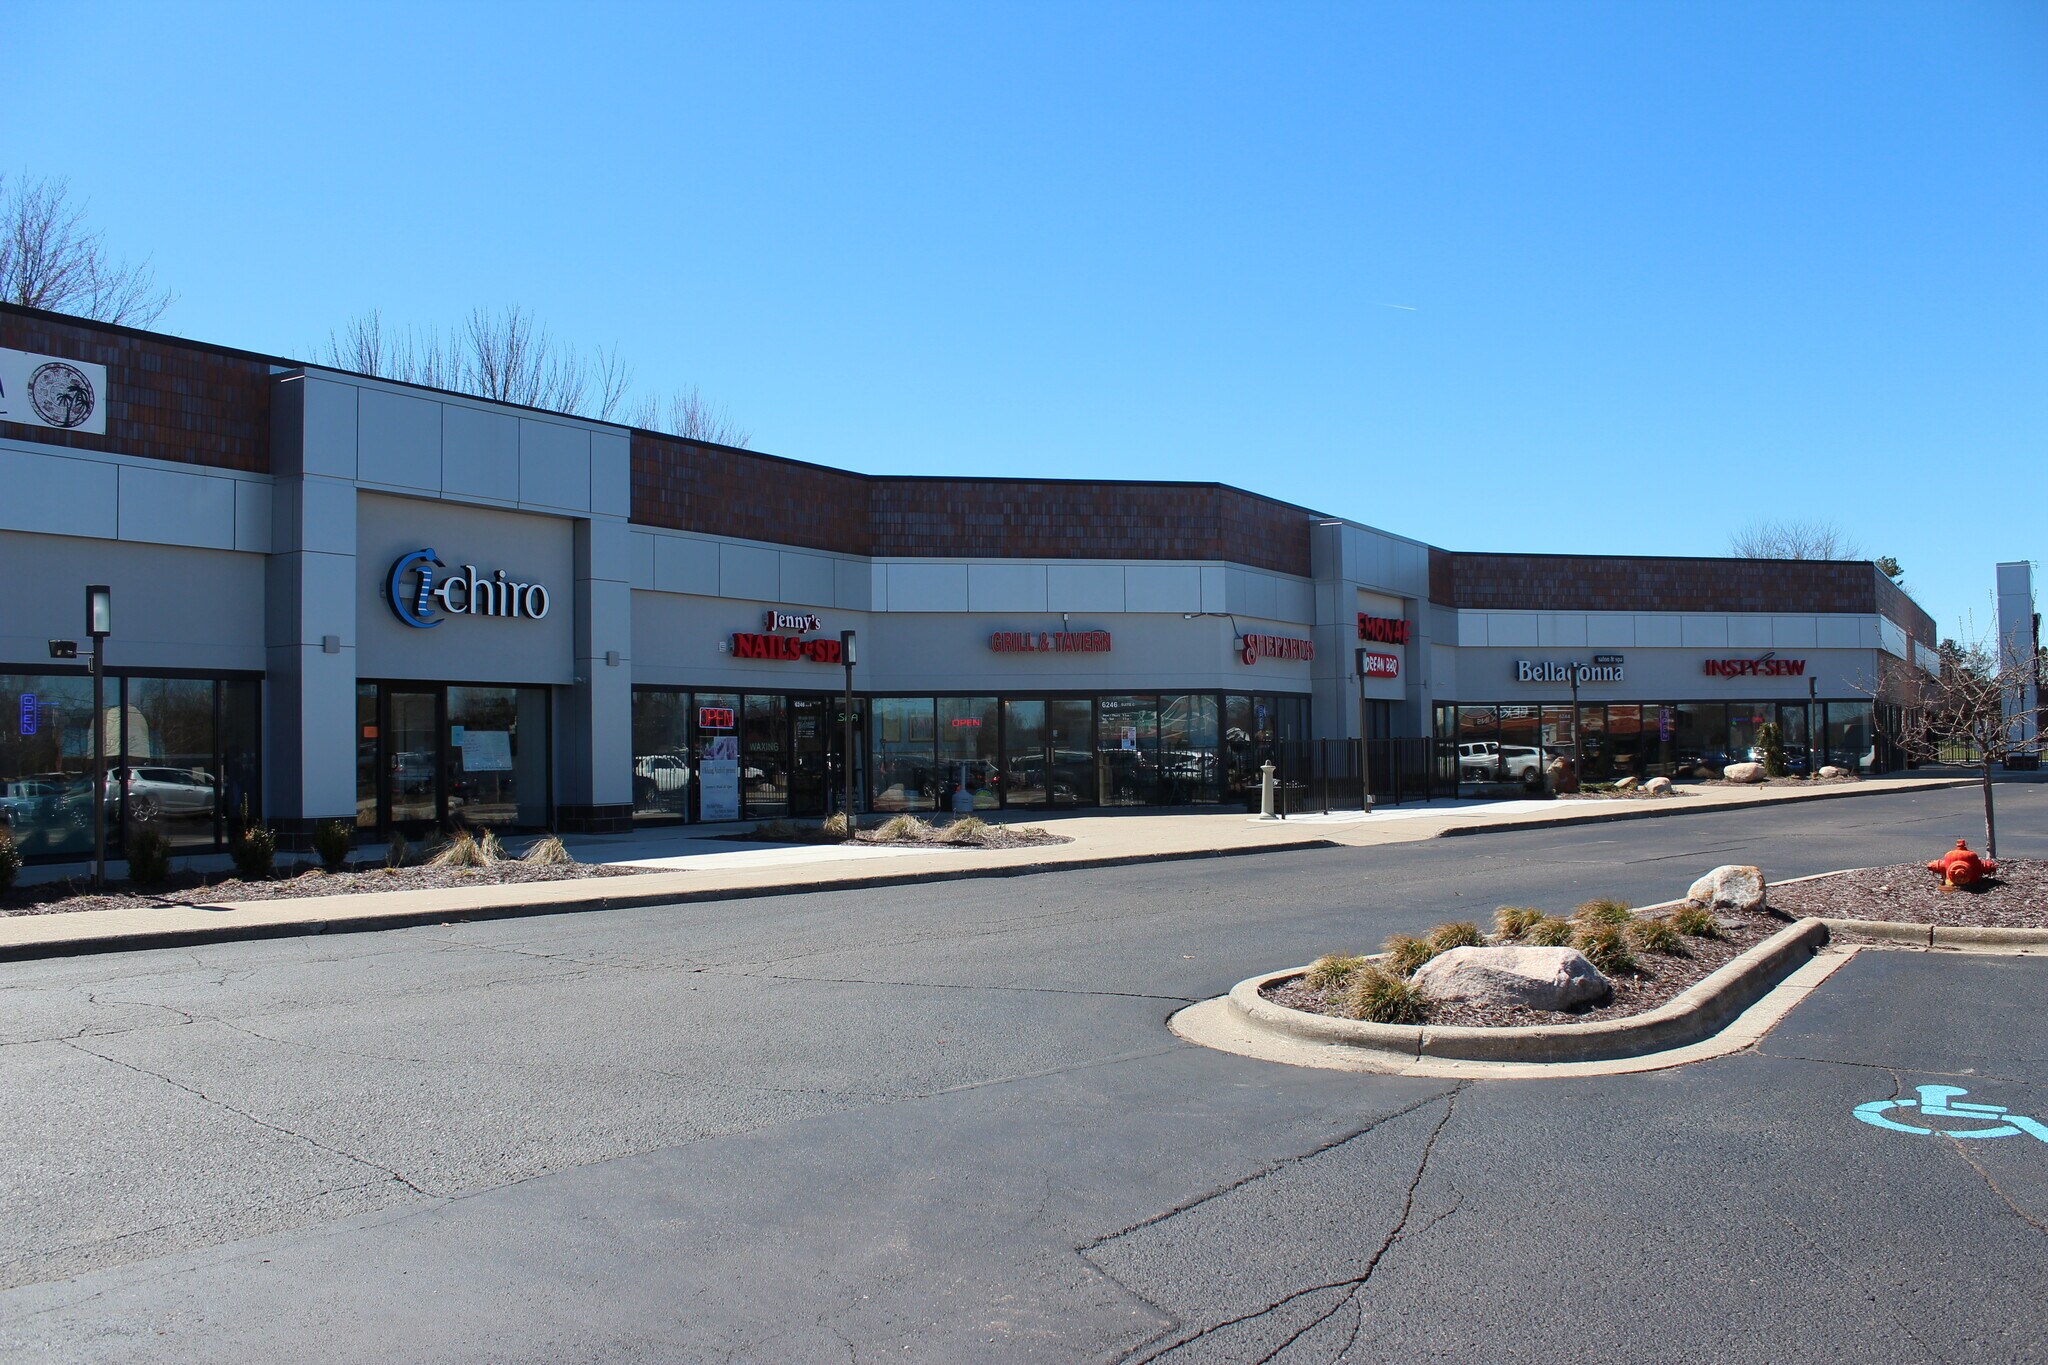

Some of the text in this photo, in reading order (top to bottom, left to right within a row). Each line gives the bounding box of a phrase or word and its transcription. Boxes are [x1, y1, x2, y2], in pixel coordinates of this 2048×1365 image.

[768, 611, 821, 633] Jenny's
[734, 633, 801, 660] NAILS
[811, 639, 842, 663] SP
[991, 631, 1112, 652] GRILL & TAVERN
[1365, 656, 1385, 671] OREAN
[23, 696, 34, 732] OPEN
[700, 708, 733, 728] OPEN
[952, 719, 981, 727] OPEN
[750, 742, 779, 752] WAXING
